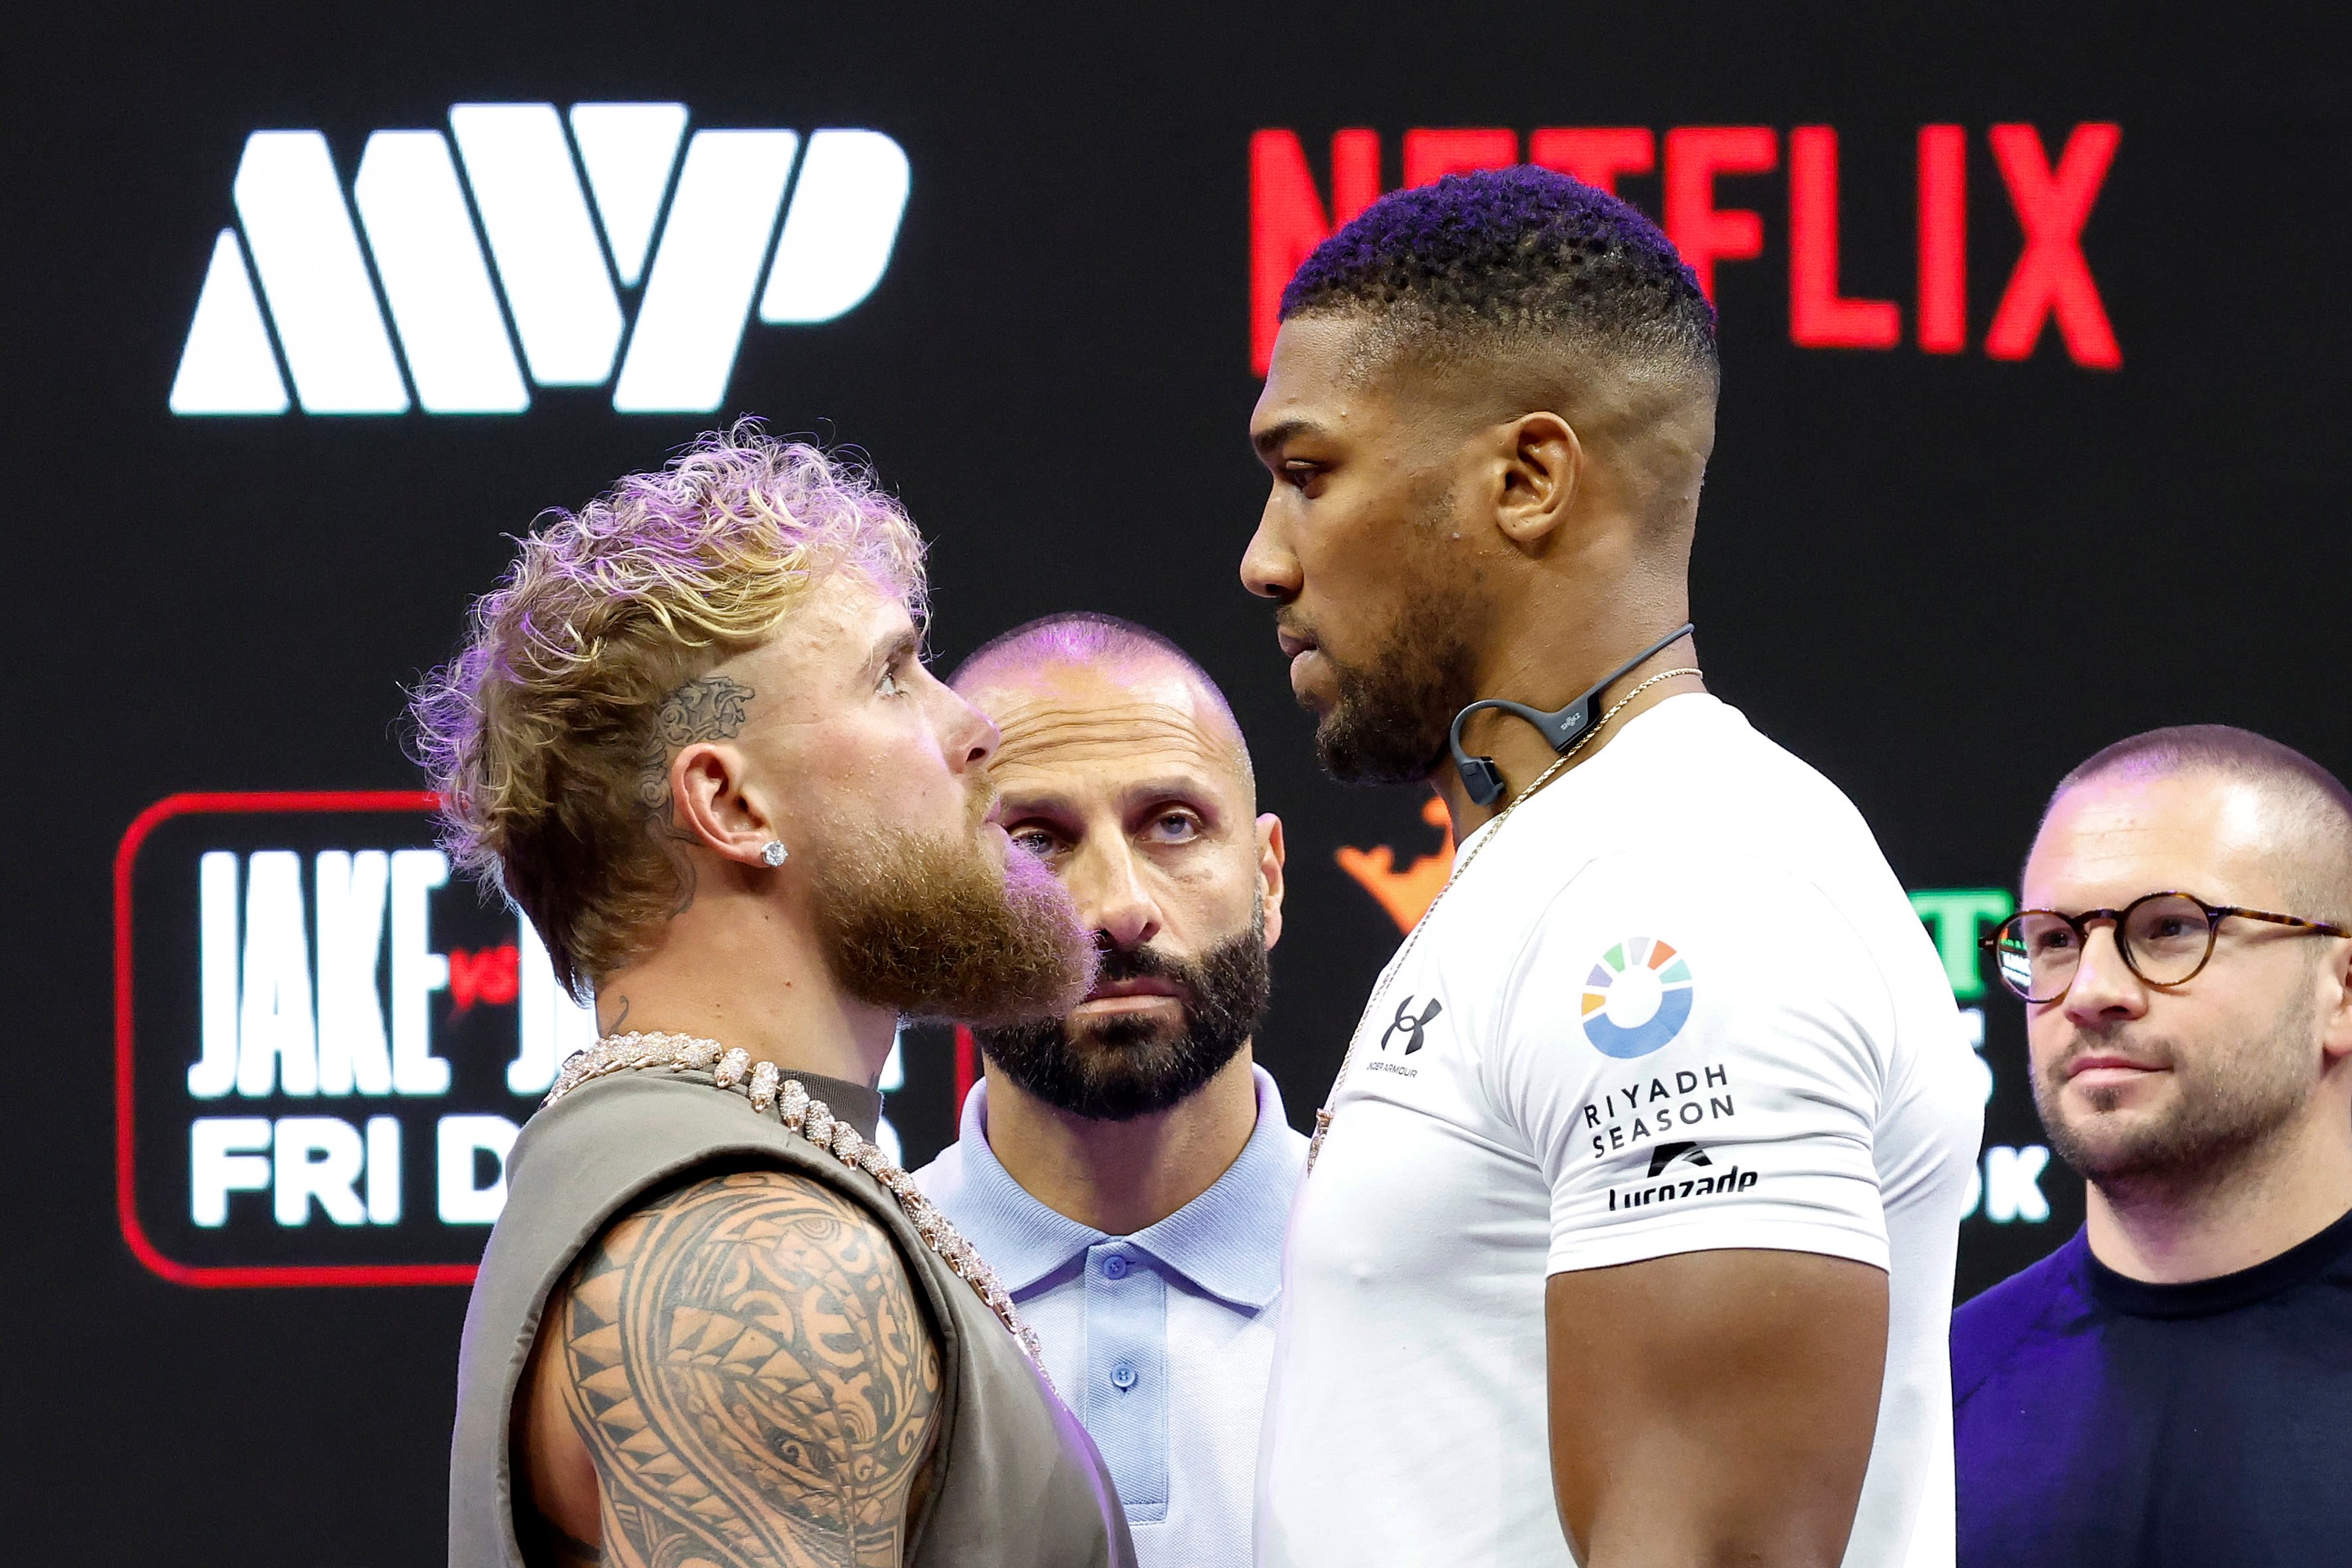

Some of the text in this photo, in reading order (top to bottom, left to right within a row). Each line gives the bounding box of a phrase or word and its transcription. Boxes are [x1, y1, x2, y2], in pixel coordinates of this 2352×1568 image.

[169, 102, 911, 414] MVP
[1249, 122, 2123, 378] NFLIX
[187, 849, 451, 1097] JAKE
[1383, 1063, 1418, 1079] ARMOUR
[1584, 1063, 1727, 1129] RIYADH
[1592, 1094, 1735, 1159] SEASON
[190, 1116, 402, 1227] FRI
